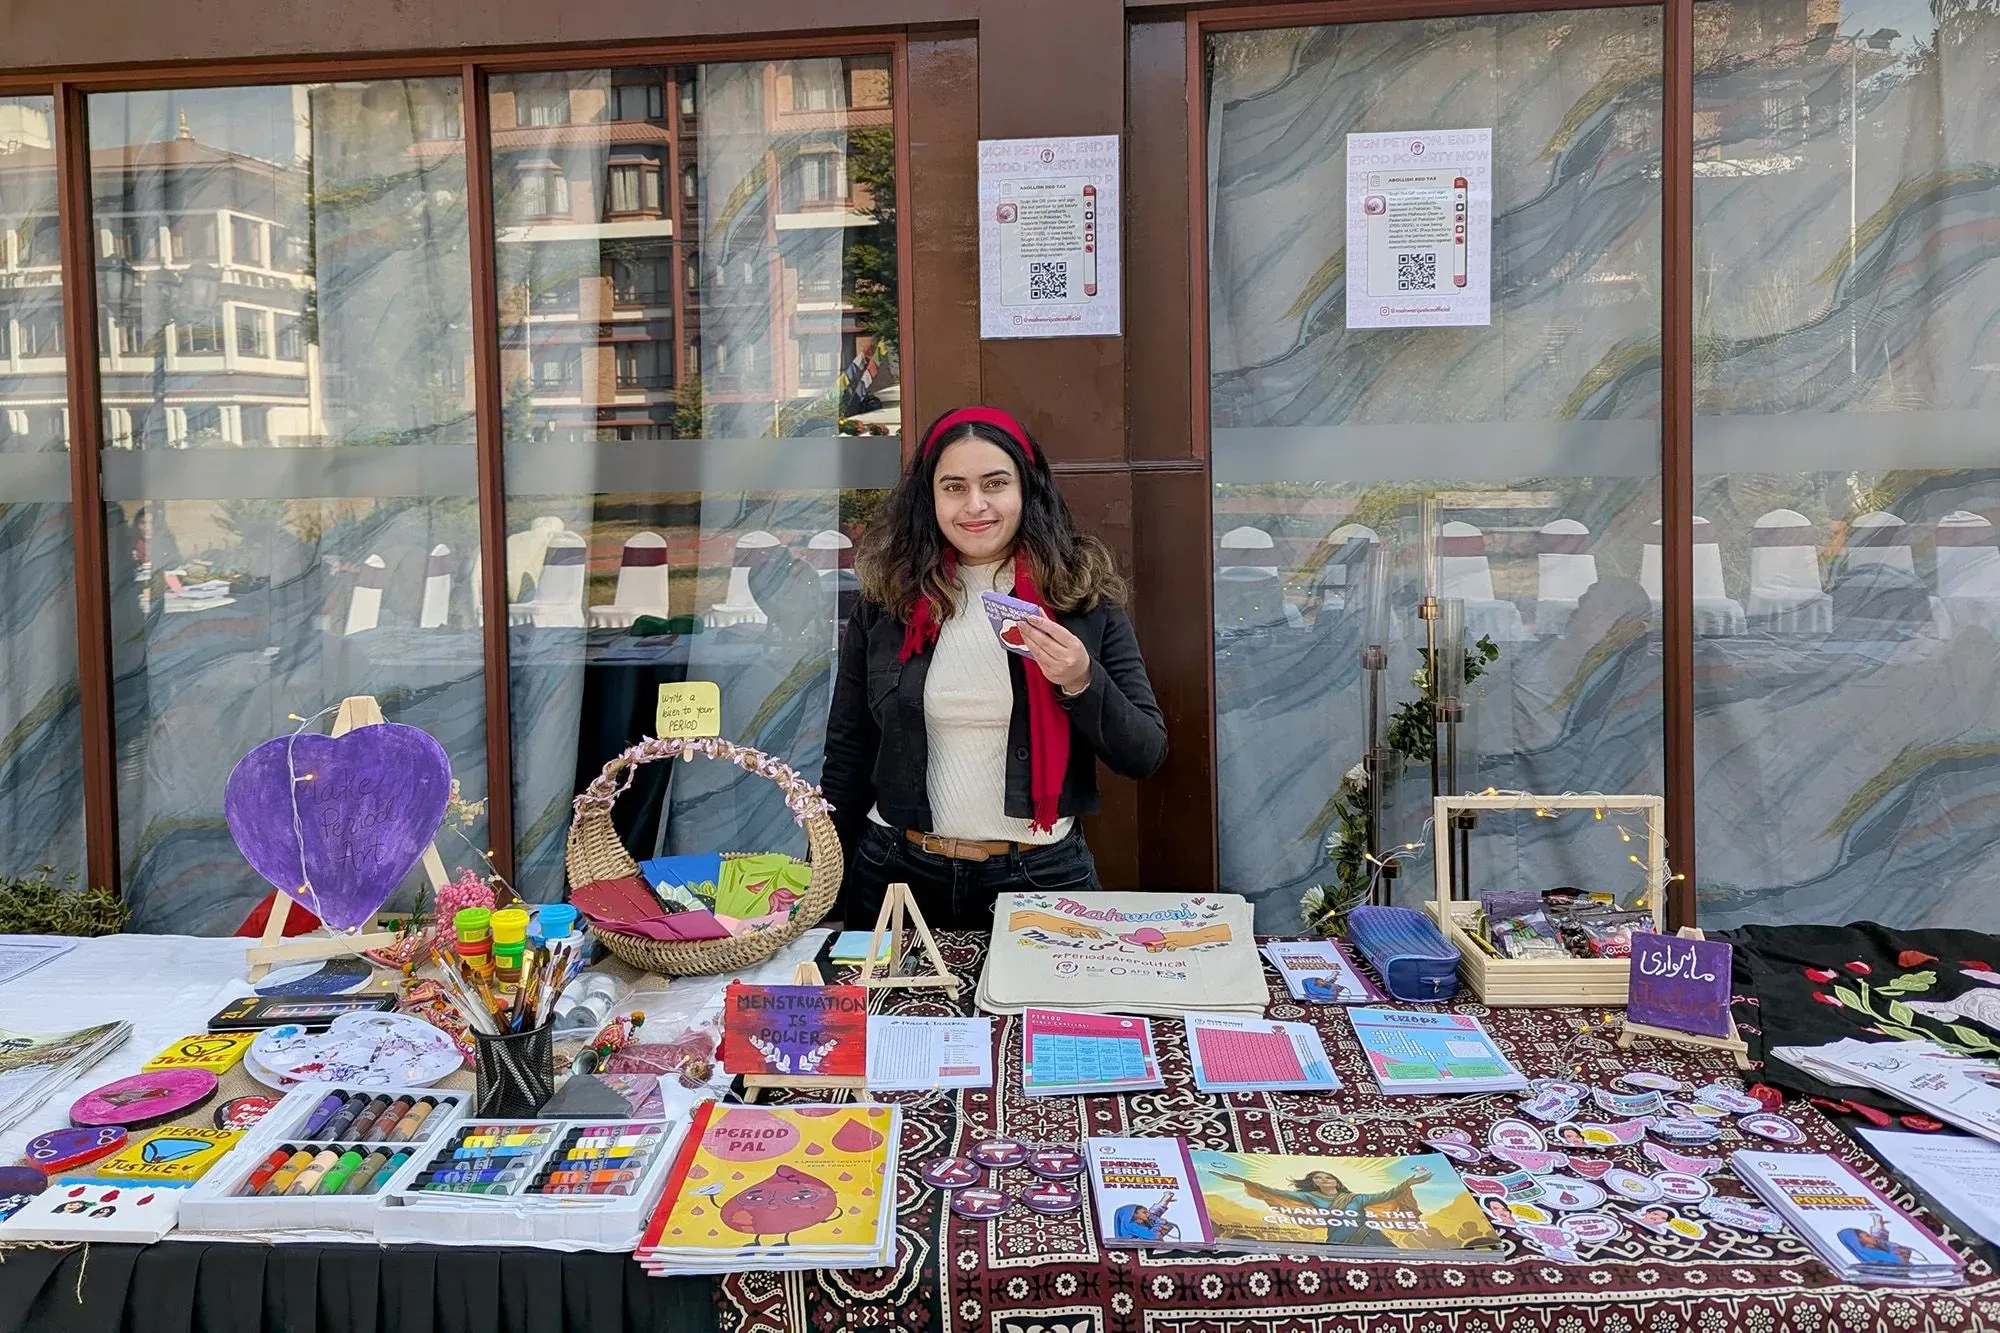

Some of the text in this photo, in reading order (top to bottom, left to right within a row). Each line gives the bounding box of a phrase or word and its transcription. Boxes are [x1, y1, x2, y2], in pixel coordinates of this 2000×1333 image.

[662, 692, 682, 703] Write
[682, 705, 692, 715] to
[696, 706, 714, 719] your
[668, 719, 698, 732] PERIOD
[321, 796, 395, 837] Period
[337, 836, 384, 872] Art
[736, 994, 867, 1012] MENSTRUATION
[788, 1014, 807, 1028] IS
[182, 1032, 255, 1040] PERIOD
[760, 1028, 822, 1046] POWER
[152, 1053, 230, 1065] JUSTICE
[158, 1127, 233, 1139] PERIOD
[714, 1127, 789, 1139] PERIOD
[728, 1141, 766, 1152] PAL
[102, 1158, 180, 1174] JUSTICE
[1100, 1160, 1158, 1168] ENDING
[1104, 1175, 1174, 1184] POVERTY
[1784, 1187, 1843, 1195] PERIOD
[1793, 1196, 1867, 1205] POVERTY
[1268, 1206, 1416, 1219] CHANDOO & THE
[1263, 1215, 1429, 1231] CRIMSON QUEST
